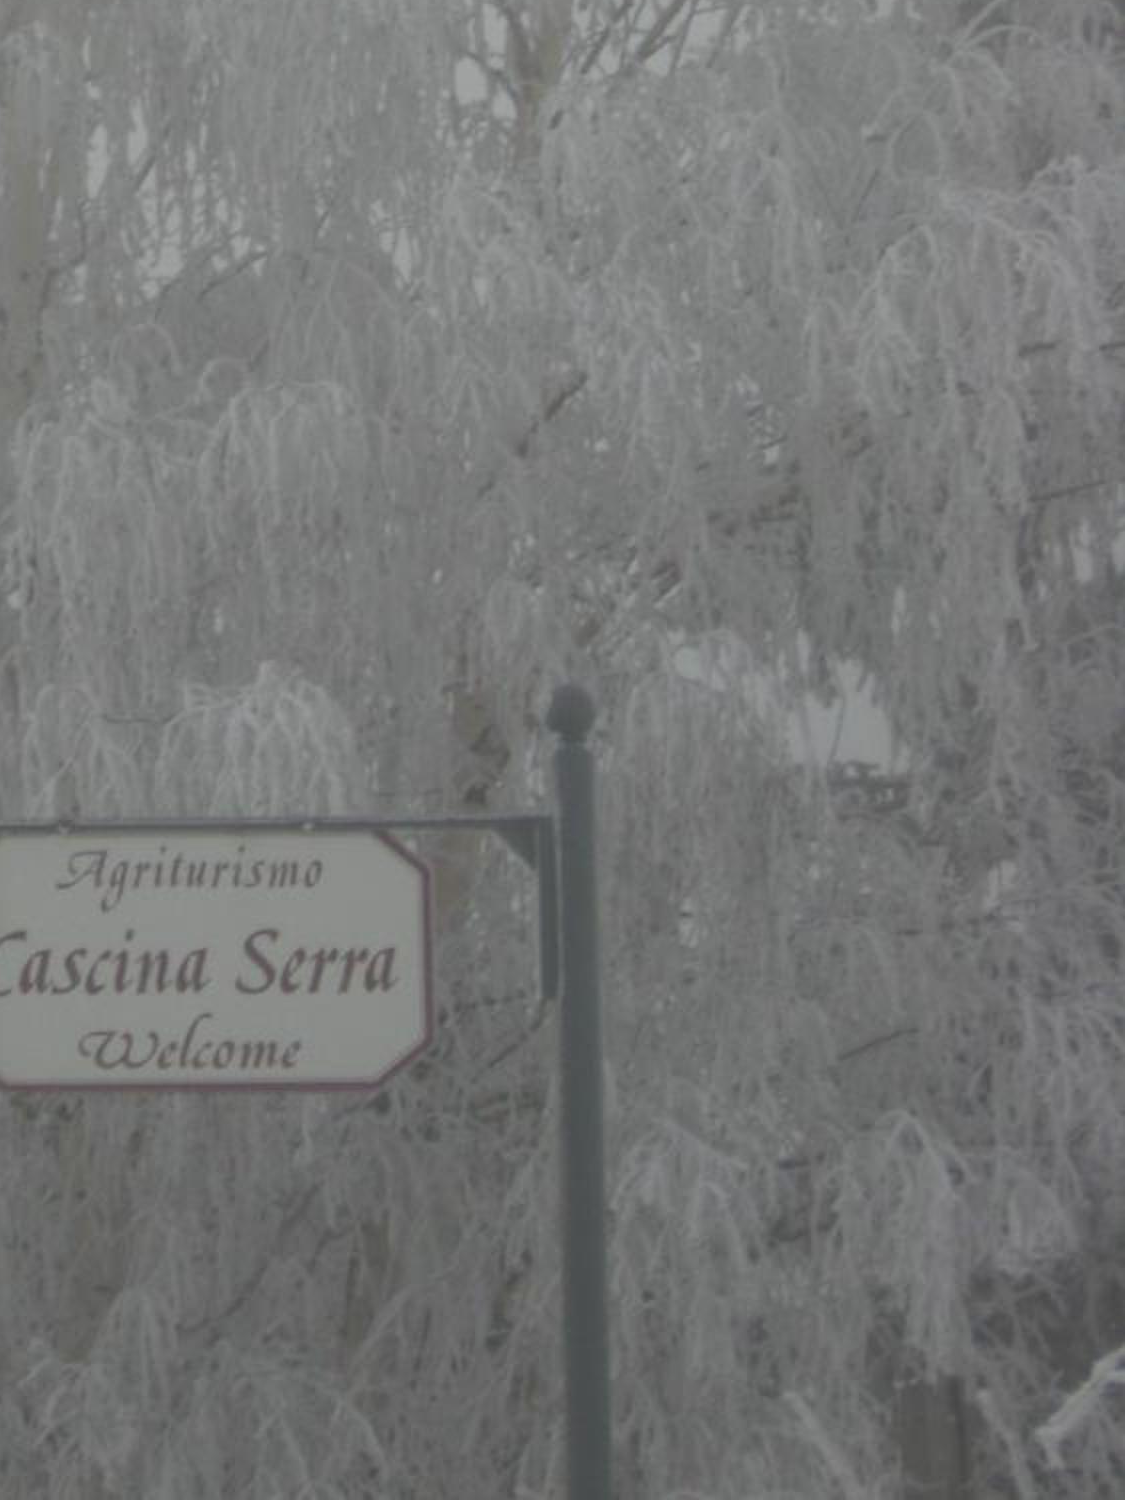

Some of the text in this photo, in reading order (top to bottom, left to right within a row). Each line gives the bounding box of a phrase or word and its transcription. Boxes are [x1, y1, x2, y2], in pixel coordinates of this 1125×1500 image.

[55, 843, 324, 913] Agriturismo
[235, 927, 400, 997] Serra
[77, 1012, 303, 1071] Welcome
